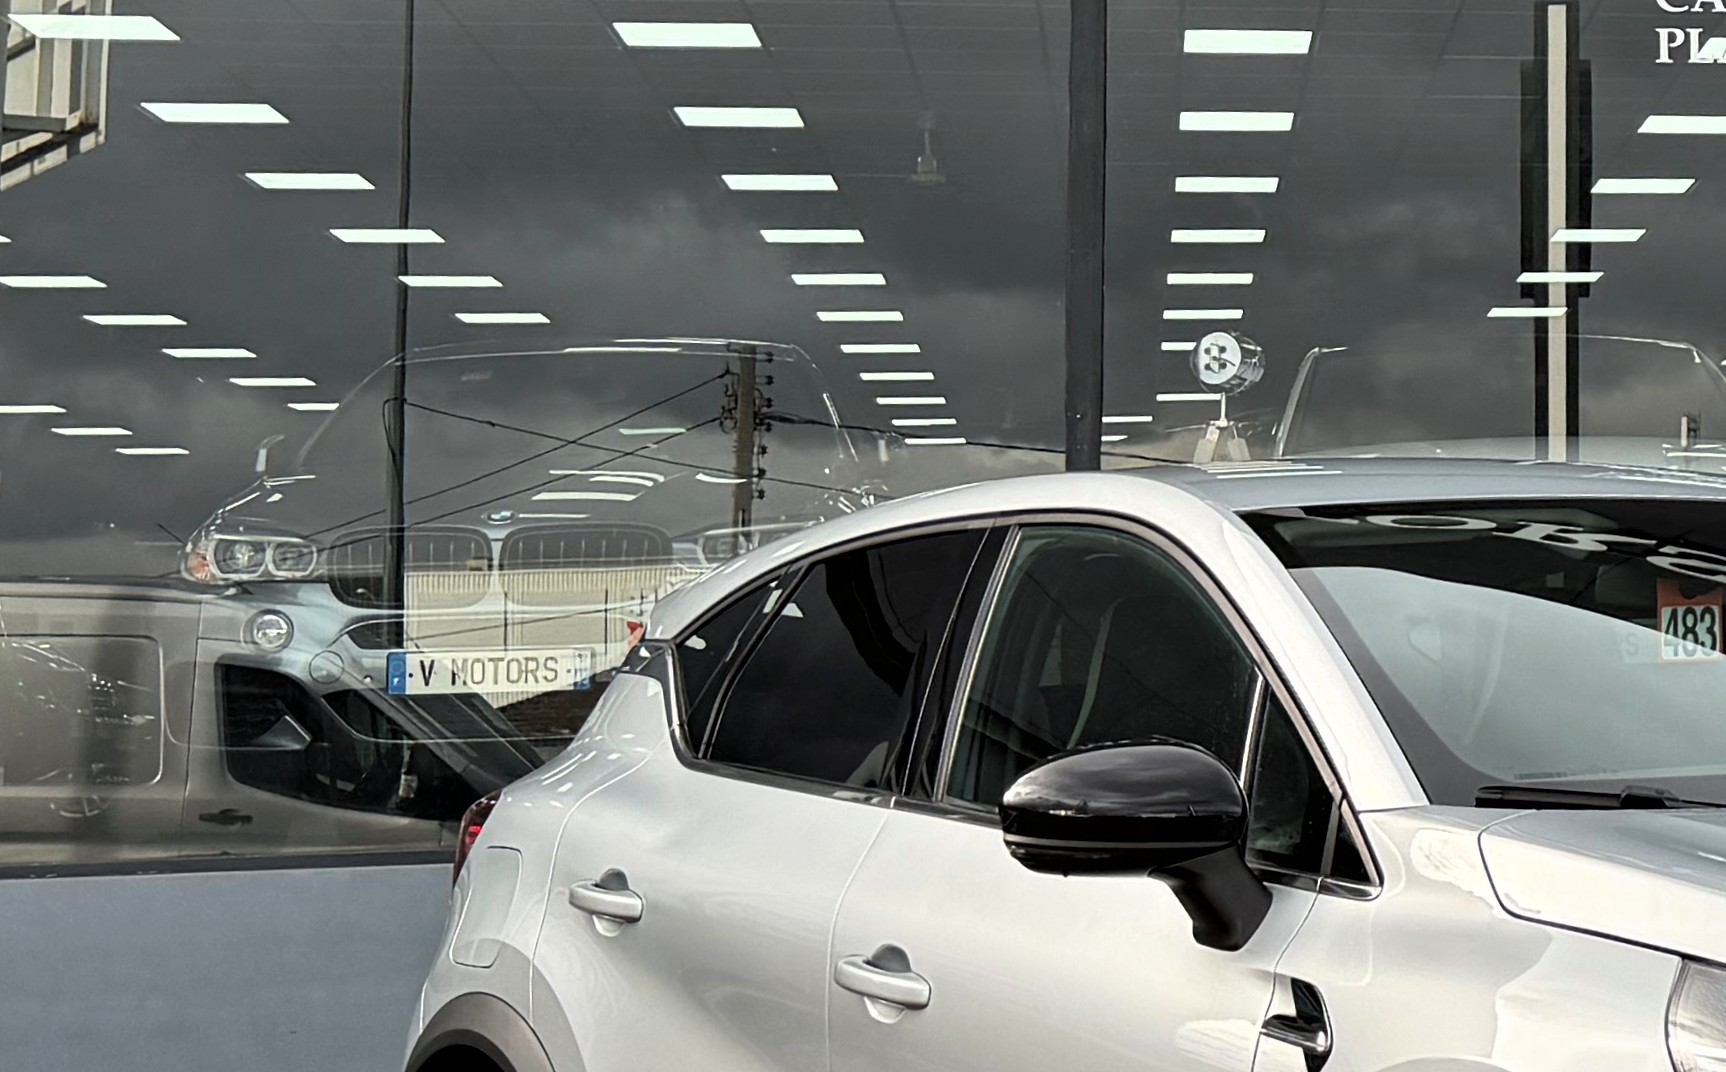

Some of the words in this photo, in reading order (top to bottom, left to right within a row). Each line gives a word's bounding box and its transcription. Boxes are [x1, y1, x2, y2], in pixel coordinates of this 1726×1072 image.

[1664, 605, 1718, 657] 483
[419, 659, 435, 687] V
[451, 656, 559, 687] MOTORS
